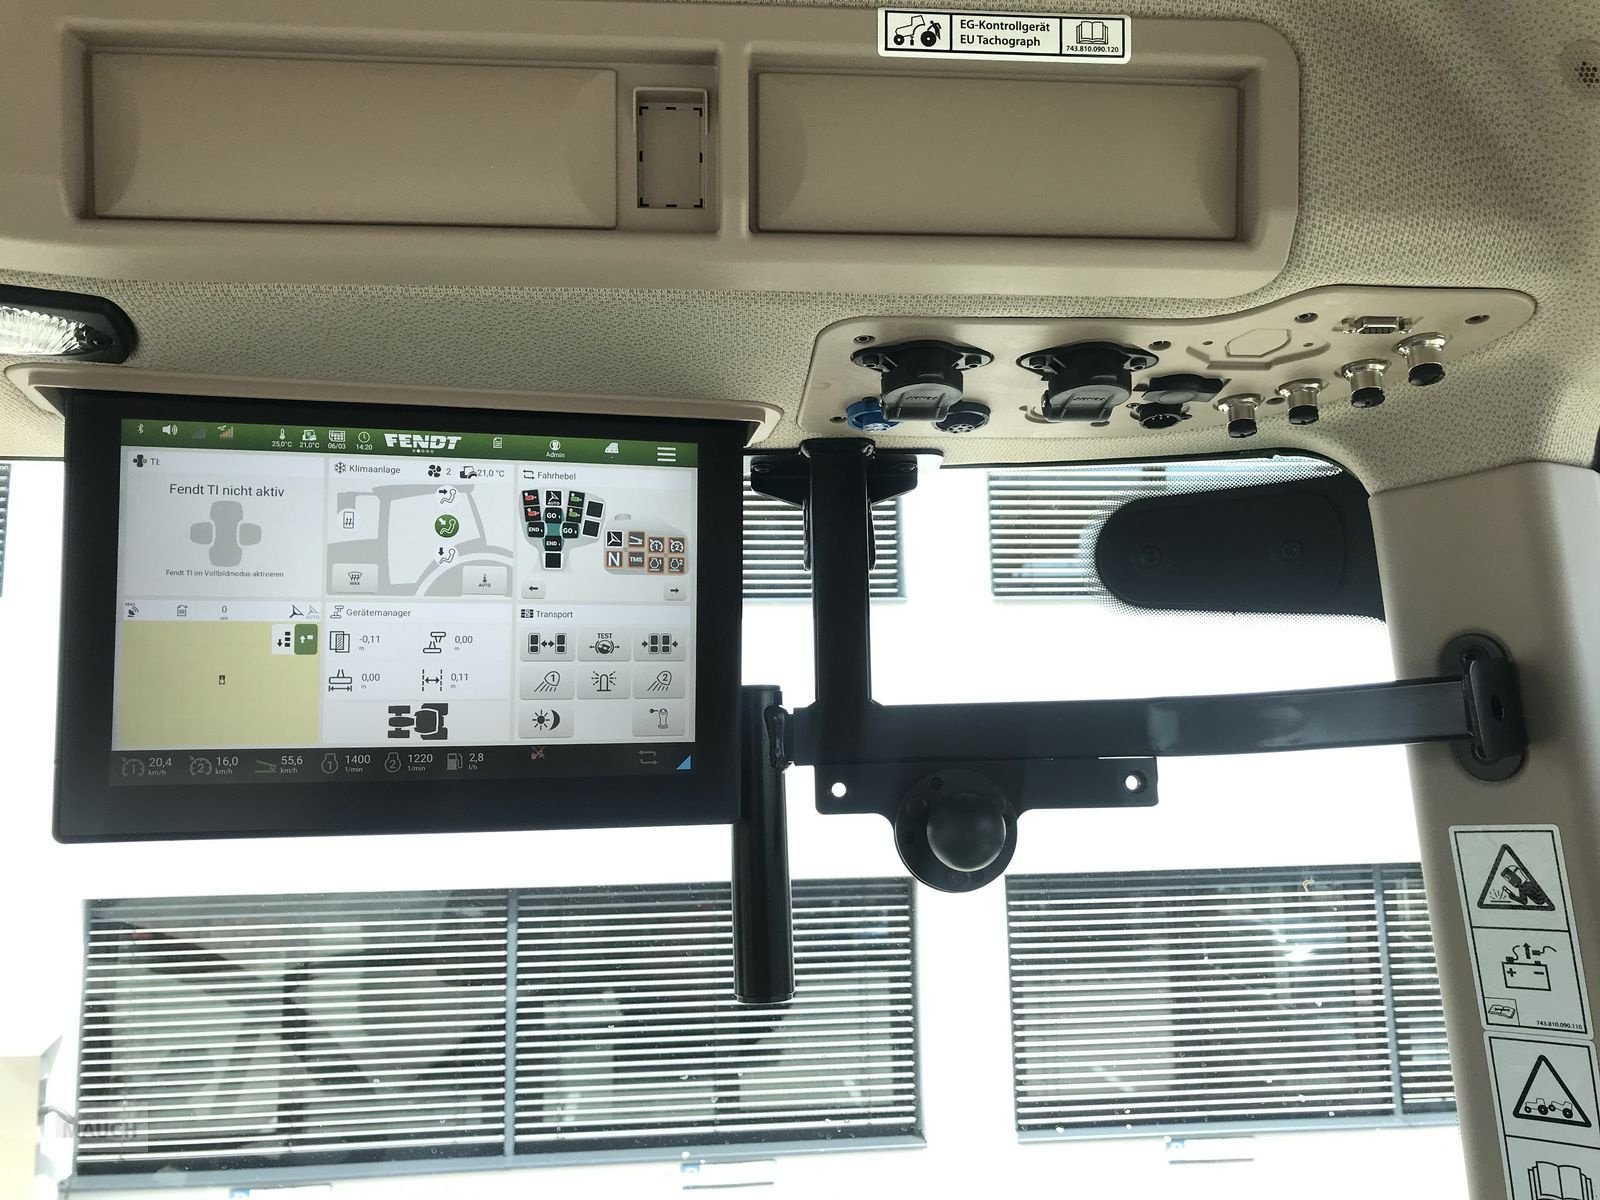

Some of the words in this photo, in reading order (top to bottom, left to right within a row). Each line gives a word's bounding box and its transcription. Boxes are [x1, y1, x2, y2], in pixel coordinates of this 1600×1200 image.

[960, 20, 1050, 33] EG-Kontrollgerät
[960, 35, 976, 44] EU
[977, 35, 1040, 47] Tachograph
[1066, 45, 1119, 53] 743.810.090.120
[272, 440, 292, 448] 25,0°C
[300, 441, 320, 449] 21,0°C
[328, 442, 346, 450] 06/03
[384, 433, 462, 450] FENDT
[349, 465, 400, 476] Klimaanlage
[446, 468, 451, 476] 2
[477, 469, 494, 478] 21,0
[495, 469, 505, 477] °C
[537, 471, 576, 480] Fahrhebel
[169, 484, 204, 495] Fendt
[207, 484, 219, 495] TI
[222, 485, 253, 496] nicht
[256, 486, 285, 497] aktiv
[608, 552, 620, 566] N
[166, 569, 185, 577] Fendt
[252, 570, 284, 578] aktivieren
[221, 605, 228, 613] 0
[346, 609, 411, 618] Gerätemanager
[536, 610, 573, 619] Transport
[359, 635, 380, 645] -0,11
[454, 636, 473, 645] 0,00
[361, 673, 380, 683] 0,00
[451, 673, 469, 682] 0,11
[148, 757, 172, 768] 20,4
[216, 756, 239, 767] 16,0
[281, 755, 303, 766] 55,6
[345, 754, 371, 764] 1400
[408, 753, 433, 763] 1220
[469, 753, 484, 763] 2,8
[148, 768, 167, 776] km/h
[215, 767, 233, 775] km/h
[1536, 1020, 1583, 1030] 743.810.090.110
